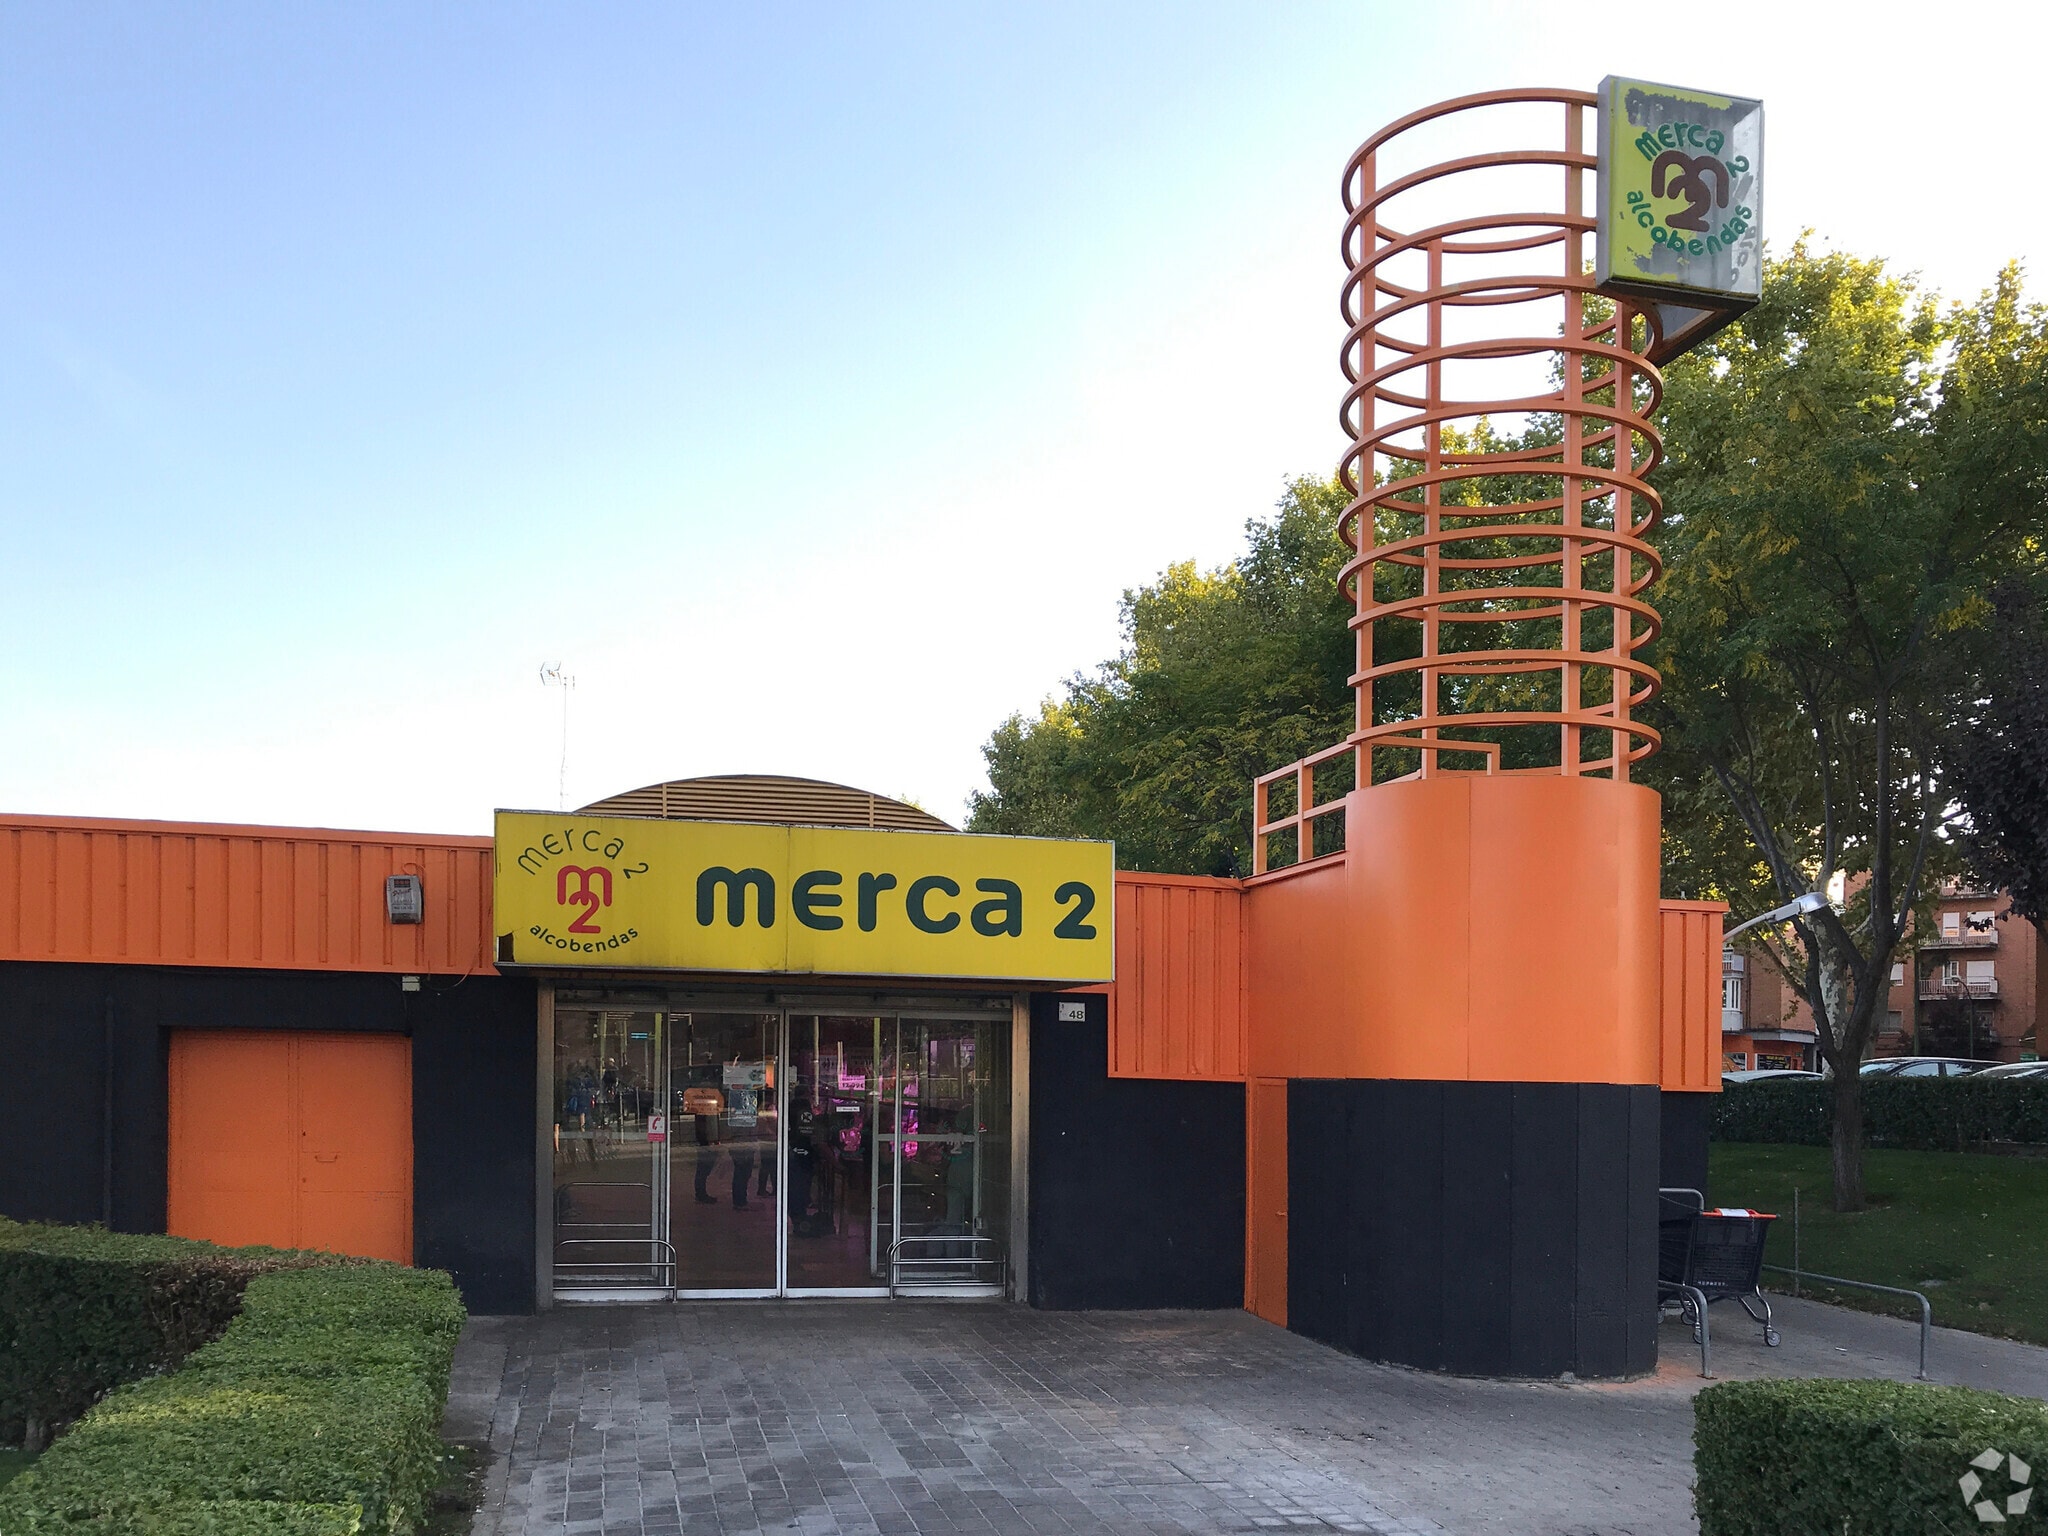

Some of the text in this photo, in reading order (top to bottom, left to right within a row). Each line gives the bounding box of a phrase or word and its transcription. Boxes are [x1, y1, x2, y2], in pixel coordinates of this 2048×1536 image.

[1635, 122, 1750, 178] merca 2
[1626, 190, 1753, 256] alcobendas
[517, 828, 650, 880] merca 2
[696, 865, 1098, 940] merca 2
[529, 924, 640, 953] alcobendas
[1068, 1010, 1085, 1020] 48
